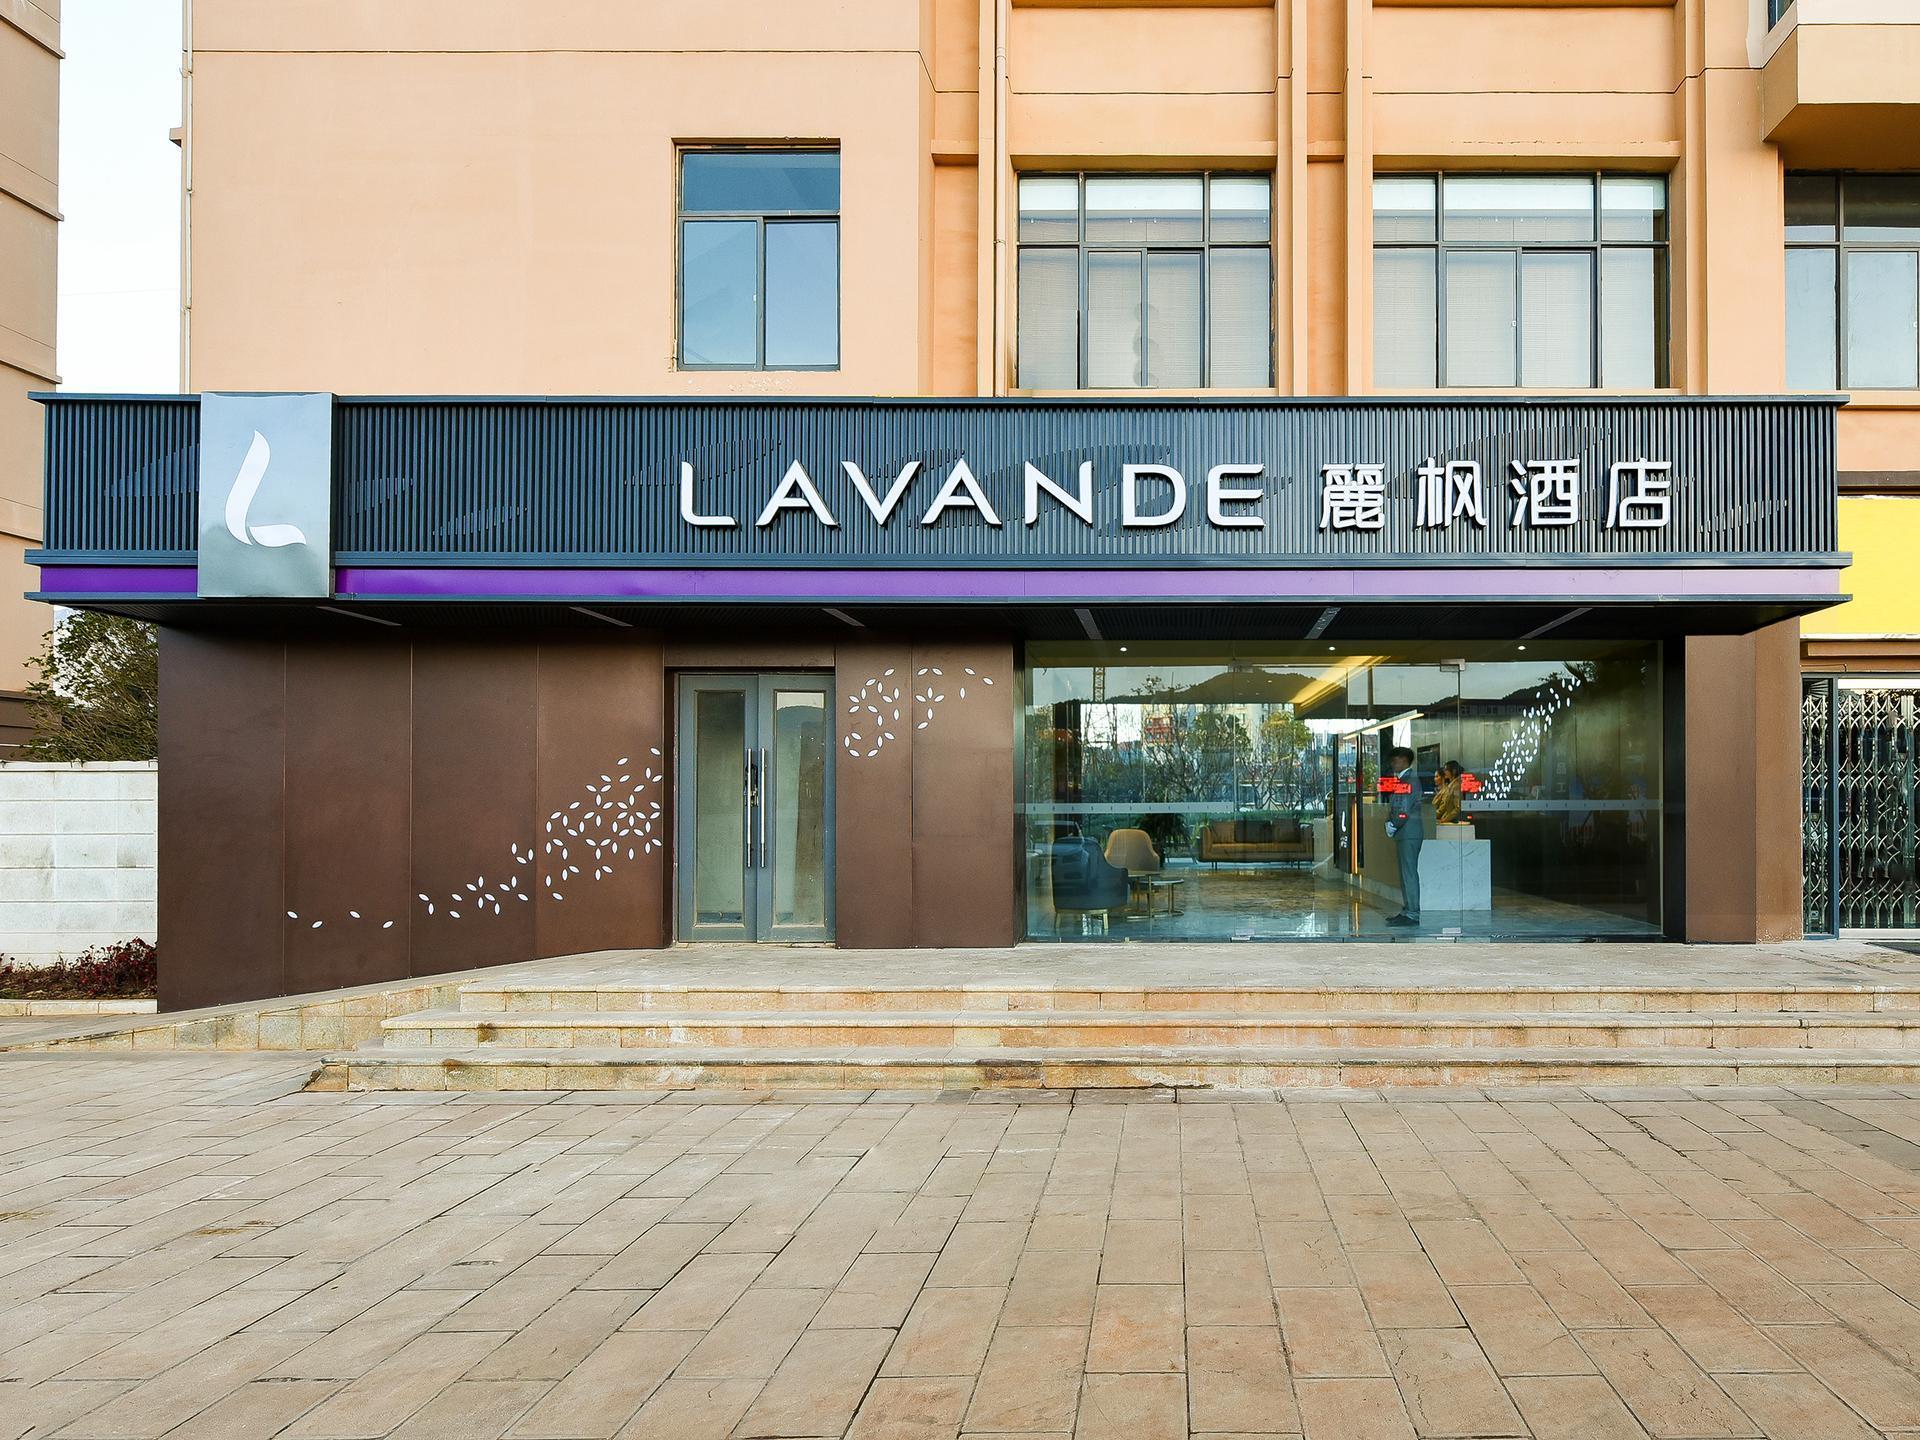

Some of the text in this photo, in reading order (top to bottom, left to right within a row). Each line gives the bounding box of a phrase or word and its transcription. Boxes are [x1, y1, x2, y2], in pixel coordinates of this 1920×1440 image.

[681, 458, 1265, 526] LAVANDE
[1319, 457, 1672, 529] 麗枫酒店
